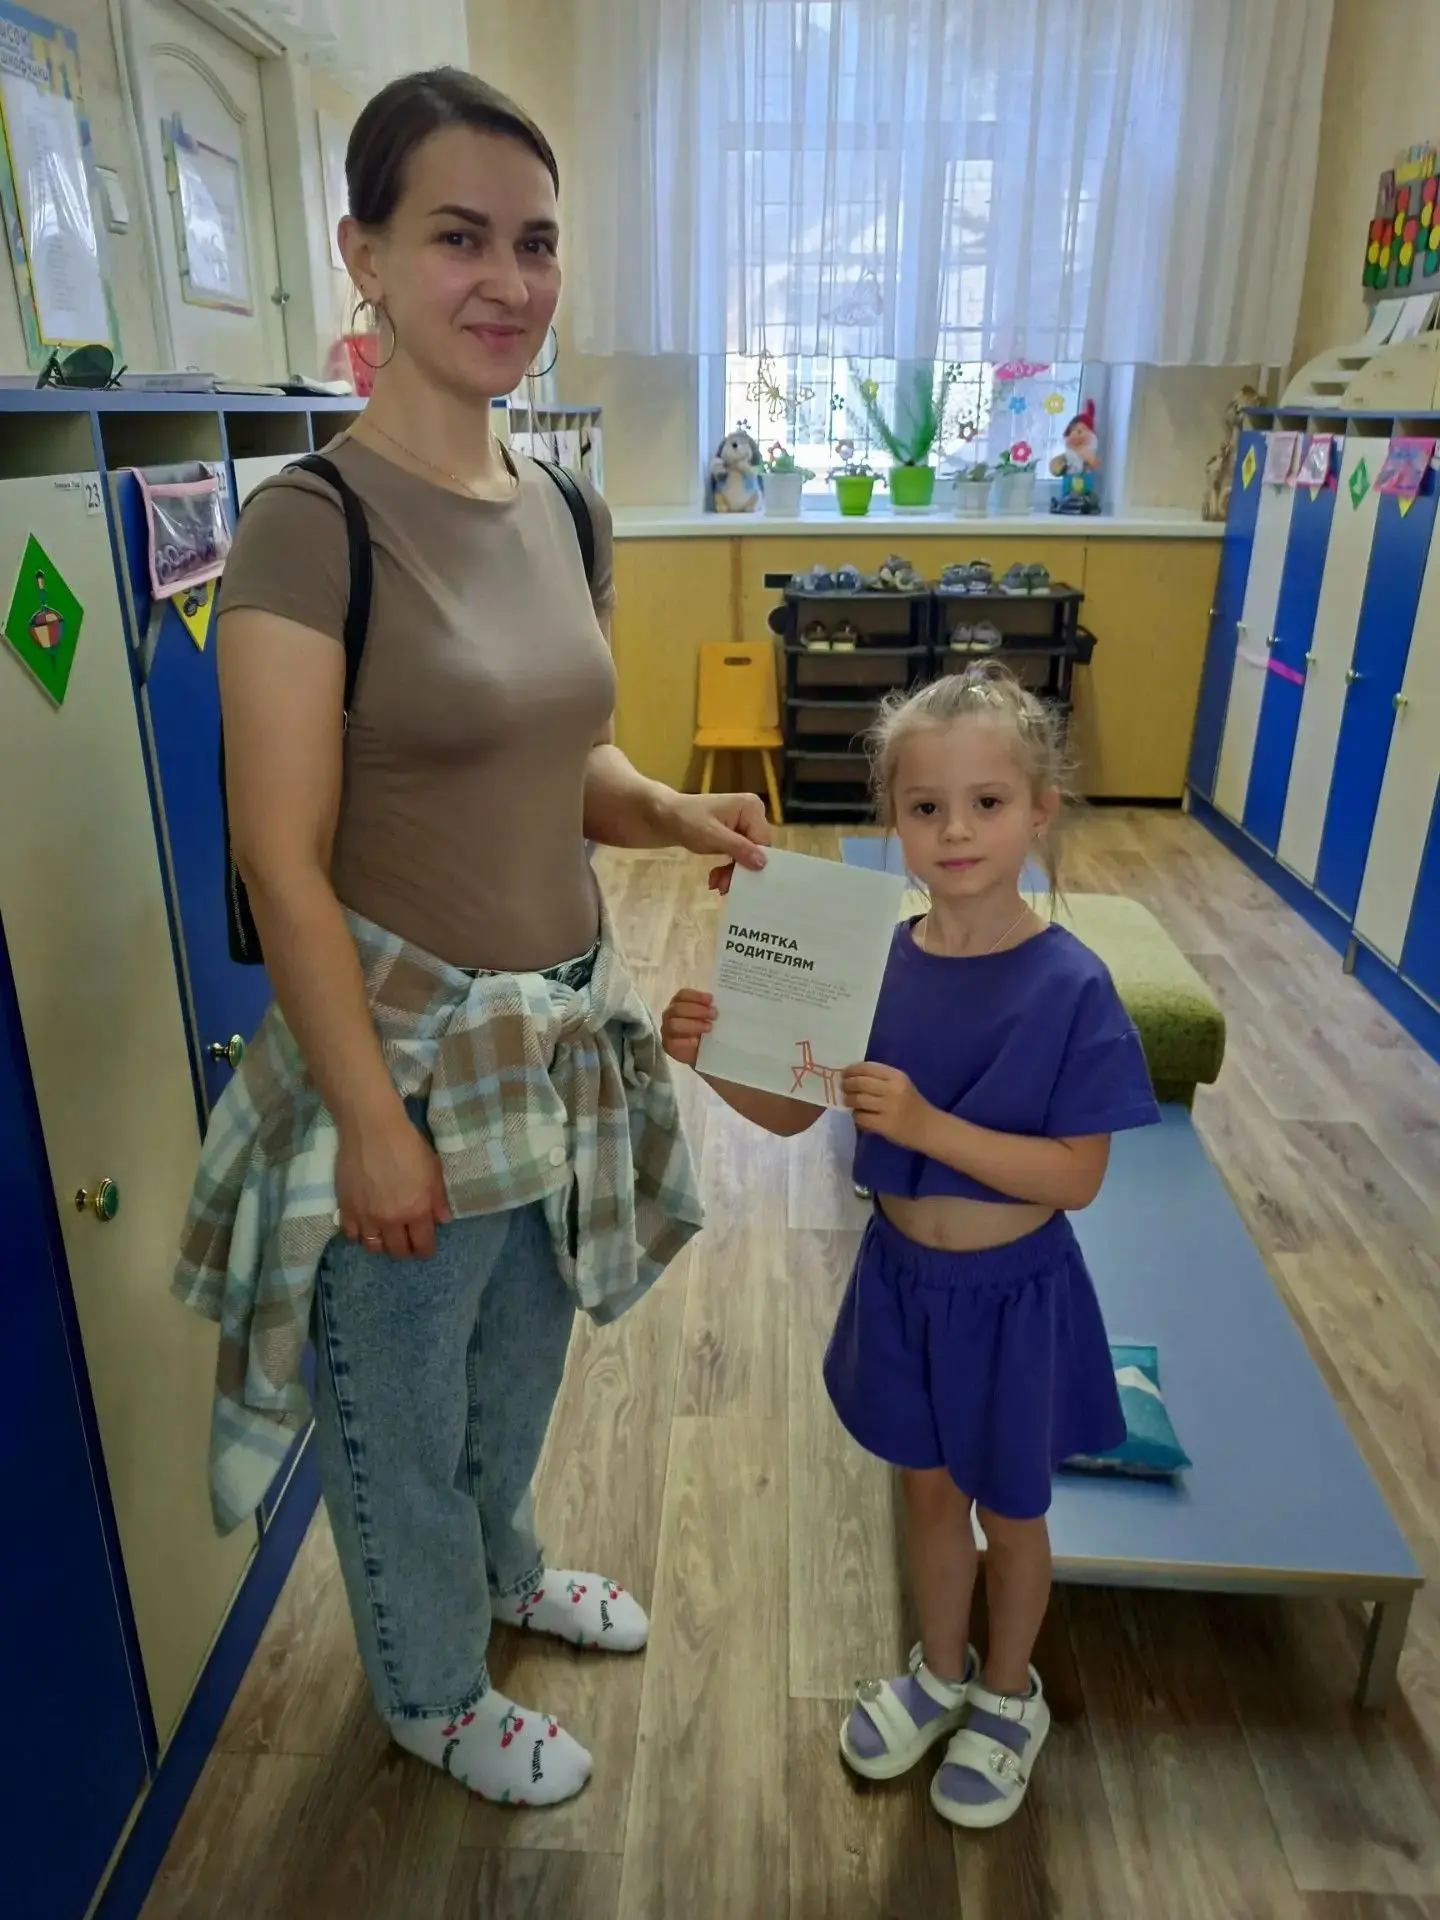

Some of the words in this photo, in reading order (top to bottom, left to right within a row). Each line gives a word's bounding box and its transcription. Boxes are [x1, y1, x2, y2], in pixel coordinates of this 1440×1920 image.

[85, 482, 100, 508] 23
[728, 924, 798, 951] ПАМЯТКА
[725, 940, 814, 971] РОДИТЕЛЯМ
